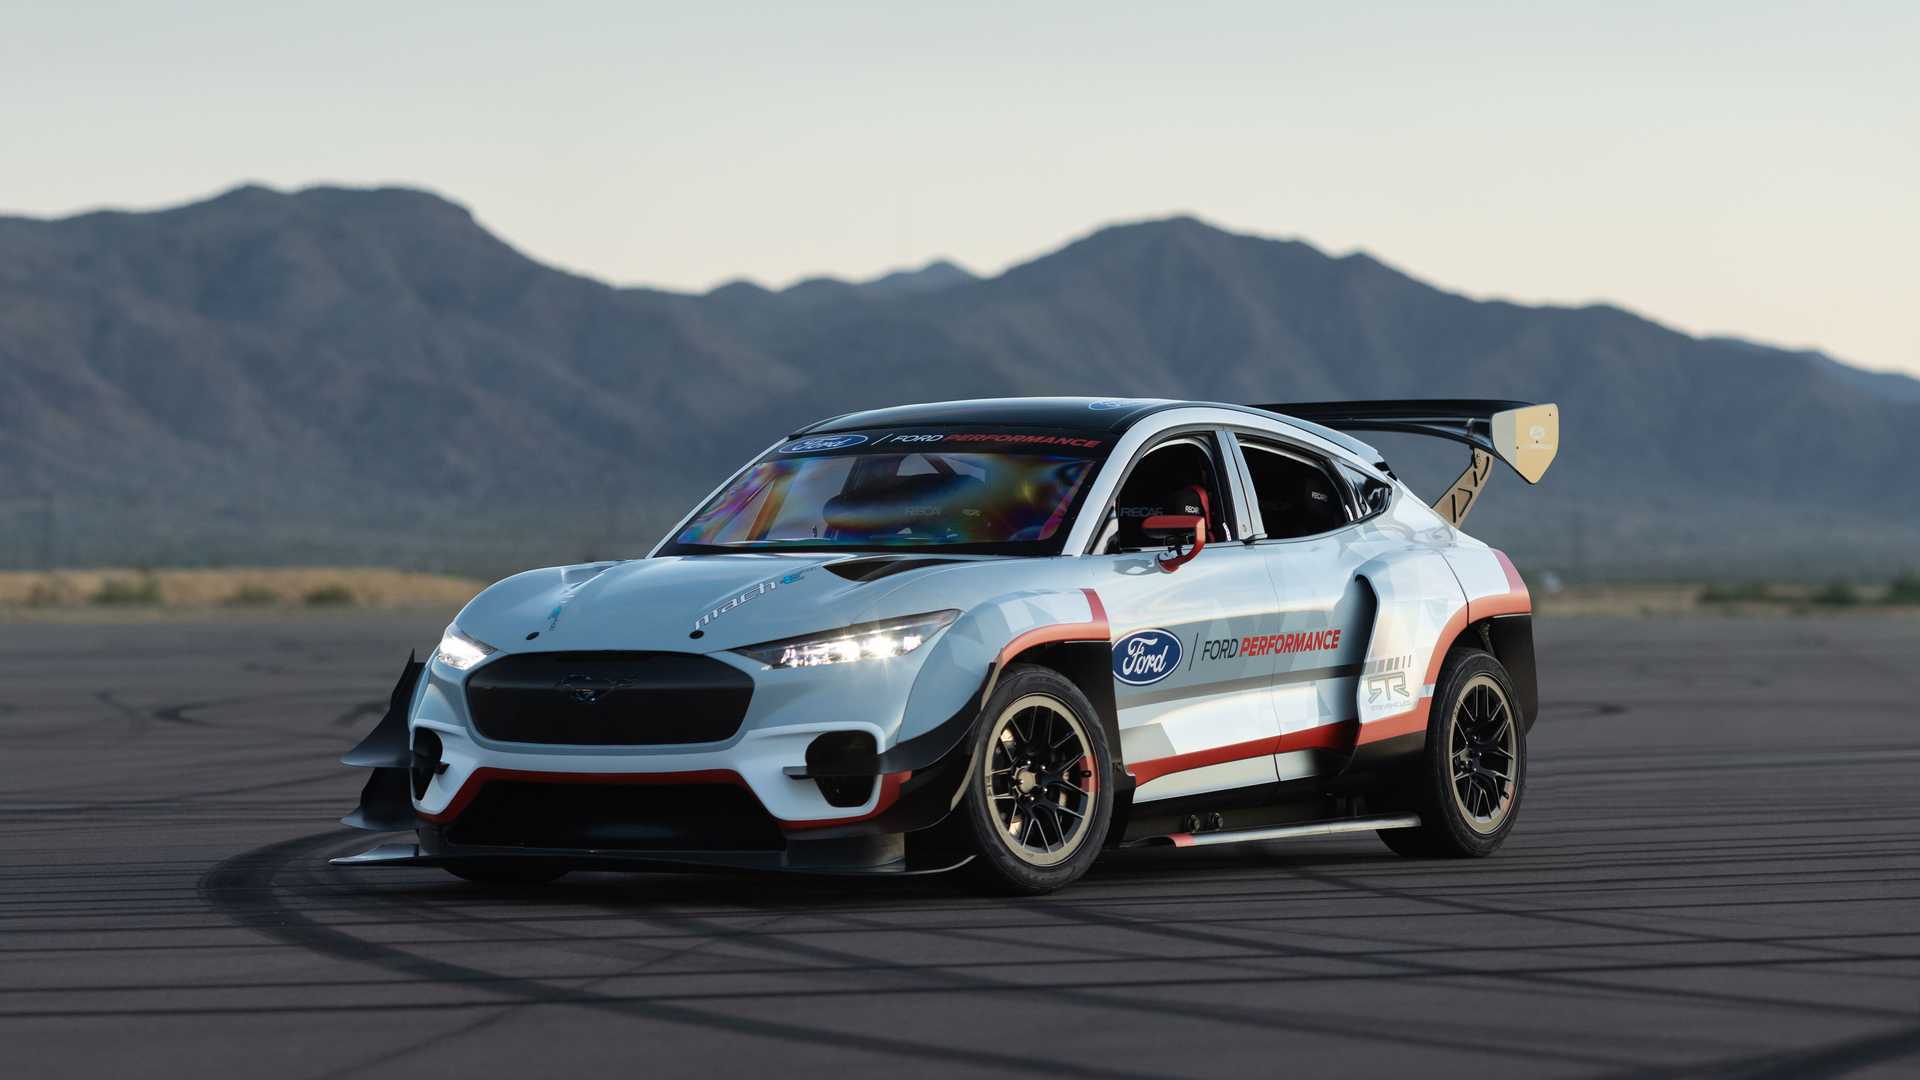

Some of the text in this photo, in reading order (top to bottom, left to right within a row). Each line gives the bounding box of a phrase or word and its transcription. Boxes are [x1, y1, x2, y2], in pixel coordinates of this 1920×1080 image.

[890, 434, 1102, 448] FORD PERFORMANCE
[1123, 637, 1167, 674] Ford
[1202, 629, 1341, 661] FORD PERFORMANCE
